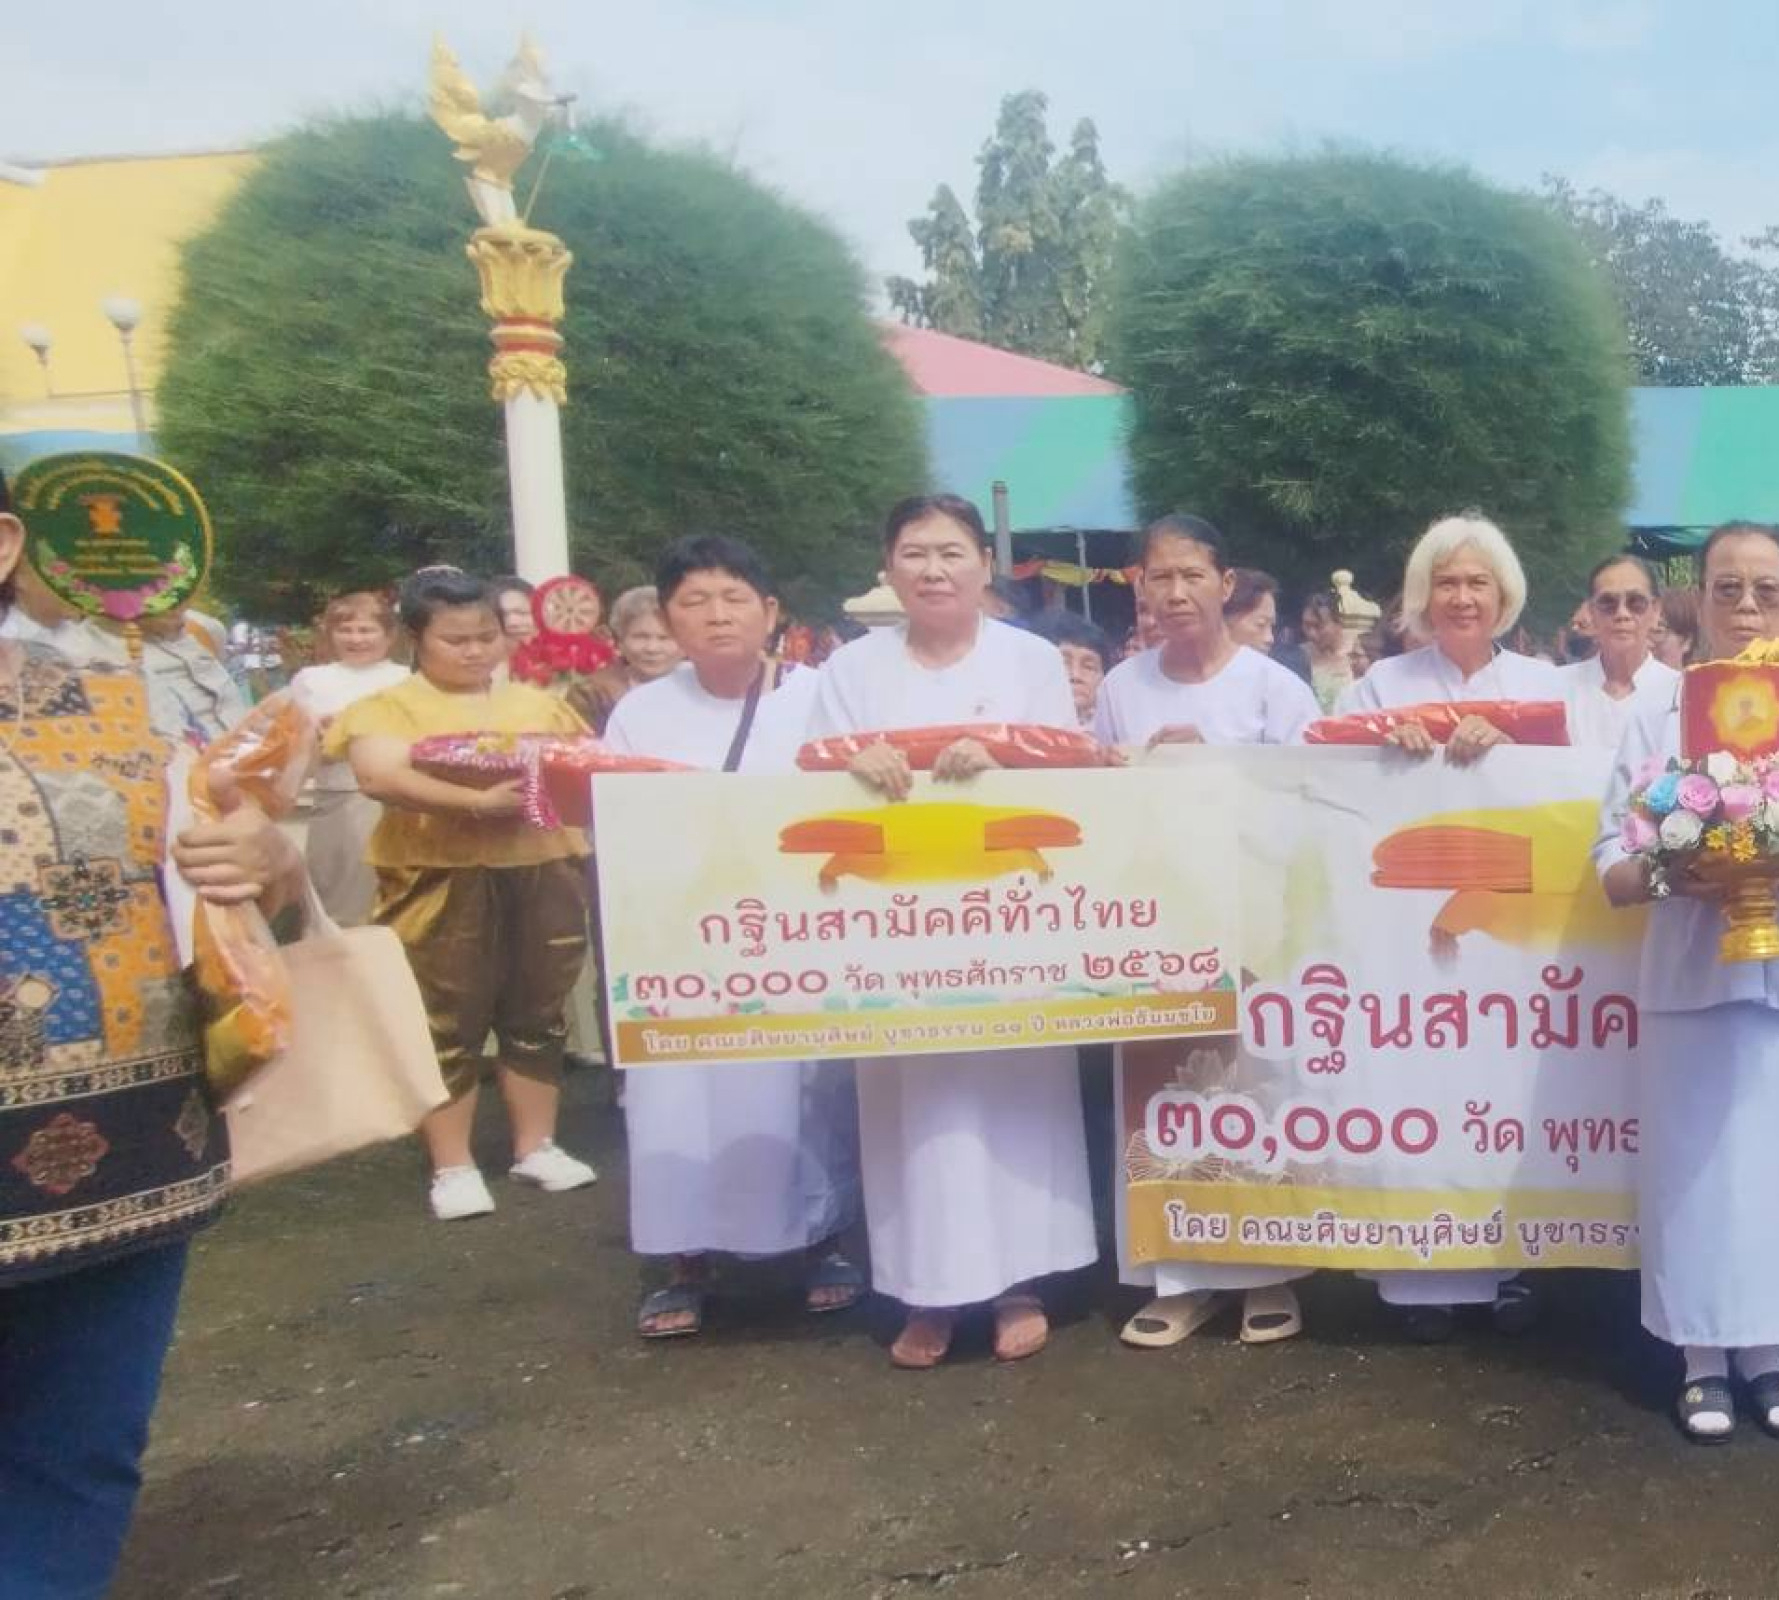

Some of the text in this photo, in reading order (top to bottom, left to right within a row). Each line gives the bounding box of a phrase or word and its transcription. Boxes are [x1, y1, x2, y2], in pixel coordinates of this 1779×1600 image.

[700, 876, 1158, 957] กฐินสามัคคีทั่วไทย
[635, 947, 1221, 1002] ๓๐,๐๐๐ วัด พุทธศักราช ๒๕๖๘
[642, 1030, 688, 1052] โดย
[1029, 1013, 1046, 1034] ปี
[1156, 1100, 1439, 1164] ๓๐,๐๐๐
[1462, 1099, 1525, 1154] วัด
[1166, 1204, 1227, 1241] โดย
[1241, 1211, 1504, 1258] คณะศิษยานุศิษย์
[1518, 1218, 1640, 1257] บูชาธร
